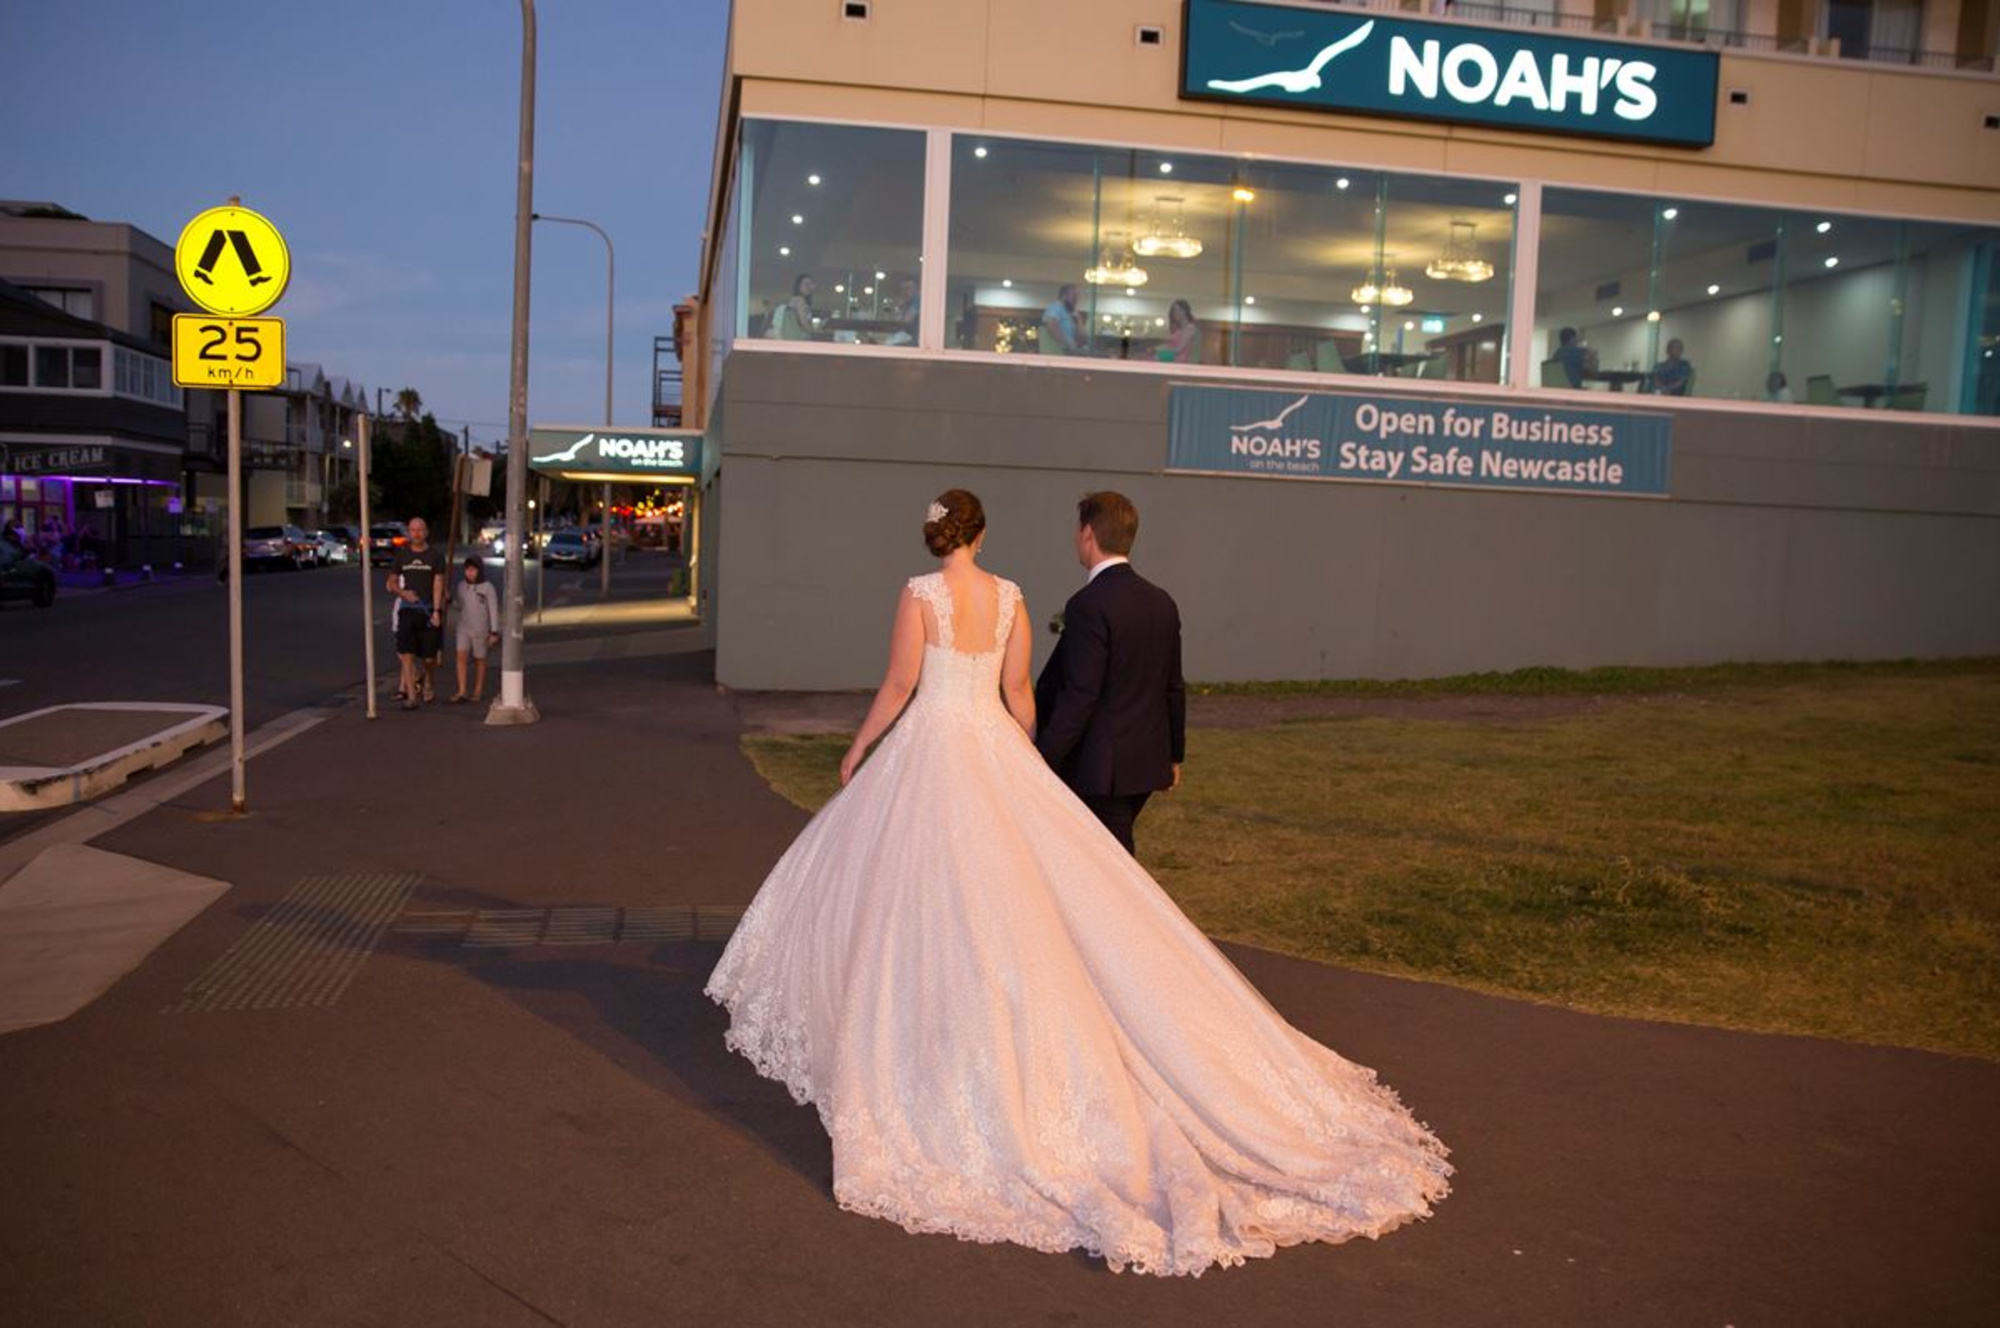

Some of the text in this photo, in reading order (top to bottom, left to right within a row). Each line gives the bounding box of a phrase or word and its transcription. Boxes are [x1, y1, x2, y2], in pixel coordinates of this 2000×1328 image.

[1388, 36, 1658, 120] NOAH'S
[198, 325, 262, 362] 25
[208, 366, 254, 379] km/h
[1355, 403, 1613, 446] Open for Business
[13, 446, 104, 472] ICE CREAM
[599, 438, 684, 460] NOAH'S
[1231, 435, 1321, 459] NOAH'S
[1250, 459, 1320, 472] on the beach
[1339, 441, 1623, 484] Stay Safe Newcastle
